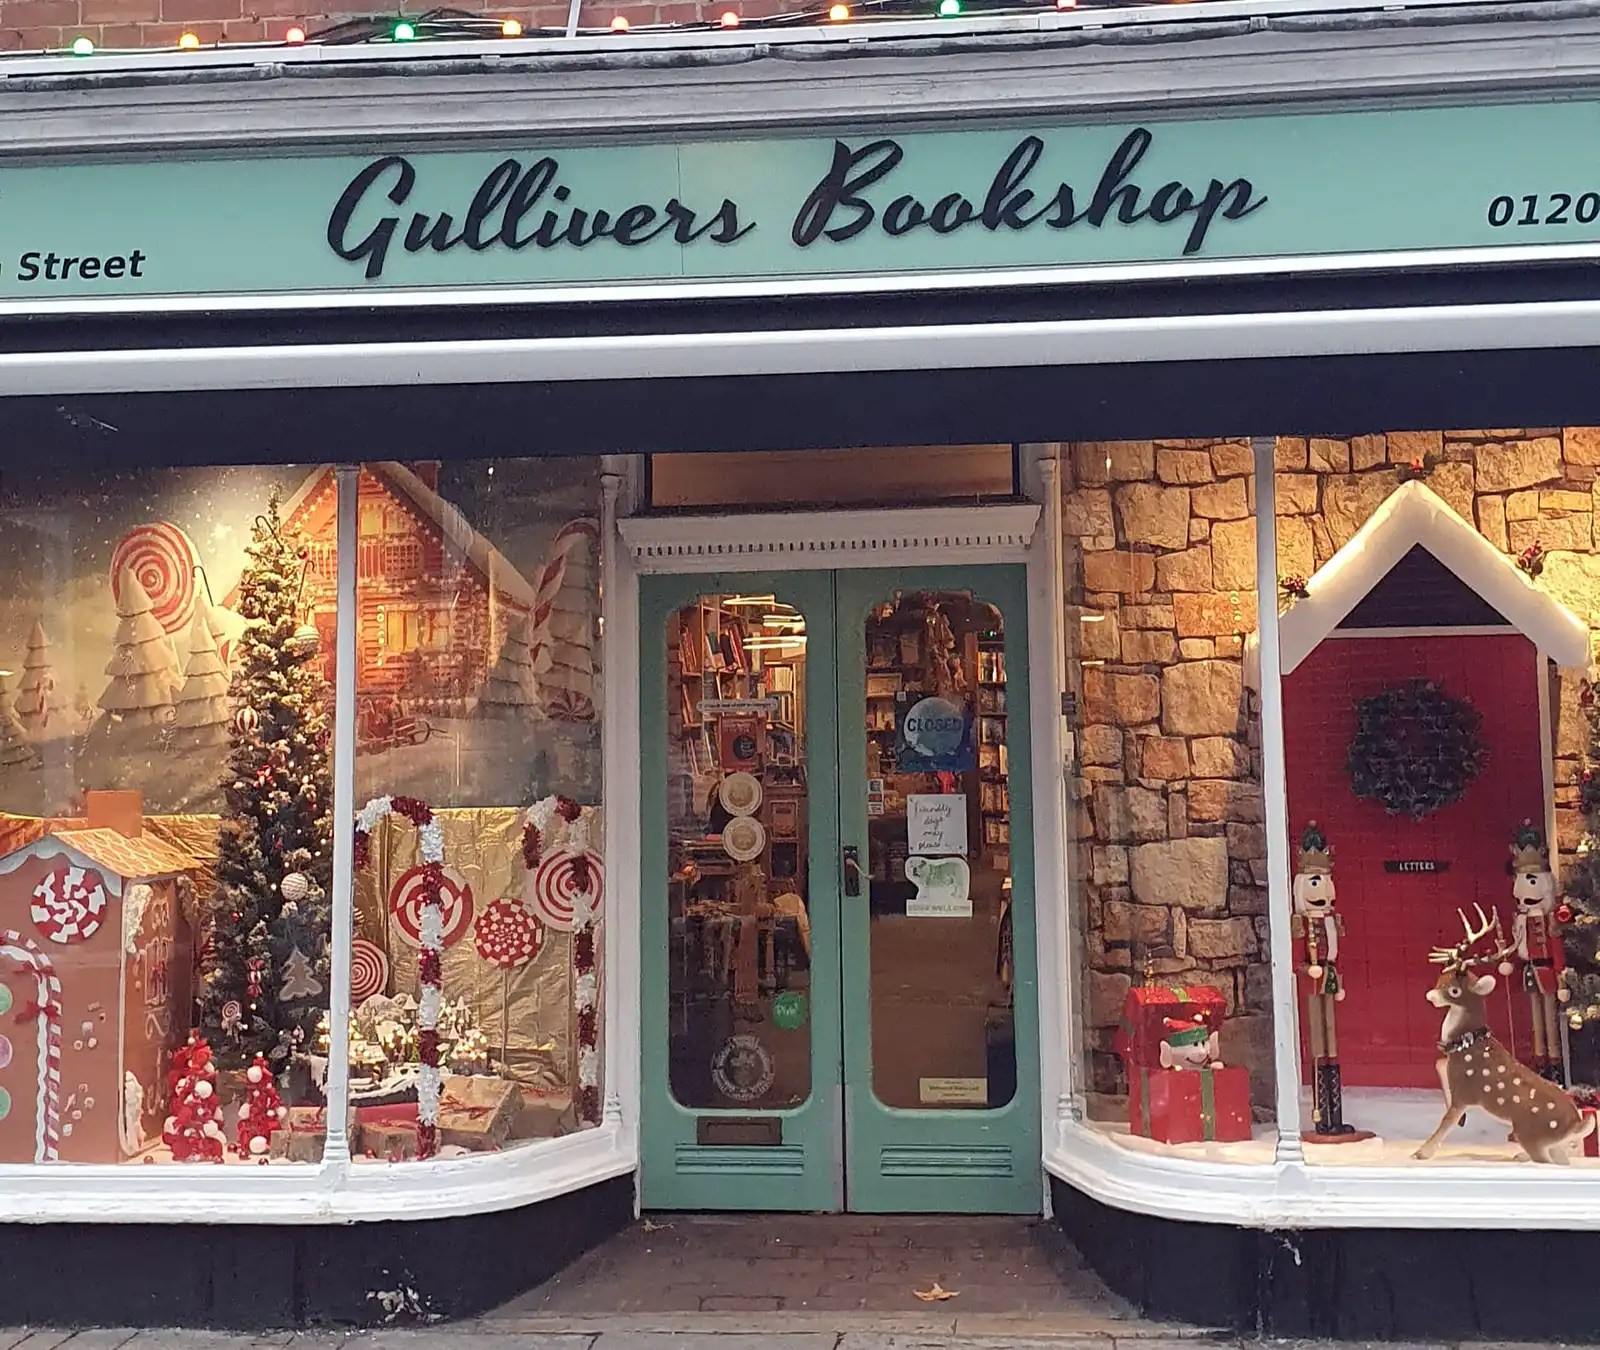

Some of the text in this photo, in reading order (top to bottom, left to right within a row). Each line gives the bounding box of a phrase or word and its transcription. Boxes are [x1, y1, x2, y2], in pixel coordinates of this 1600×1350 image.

[324, 127, 1268, 280] Gullivers Bookshop
[1487, 192, 1600, 227] 0120
[17, 249, 147, 281] Street
[907, 717, 962, 732] CLOSED
[1399, 861, 1435, 871] LETTERS
